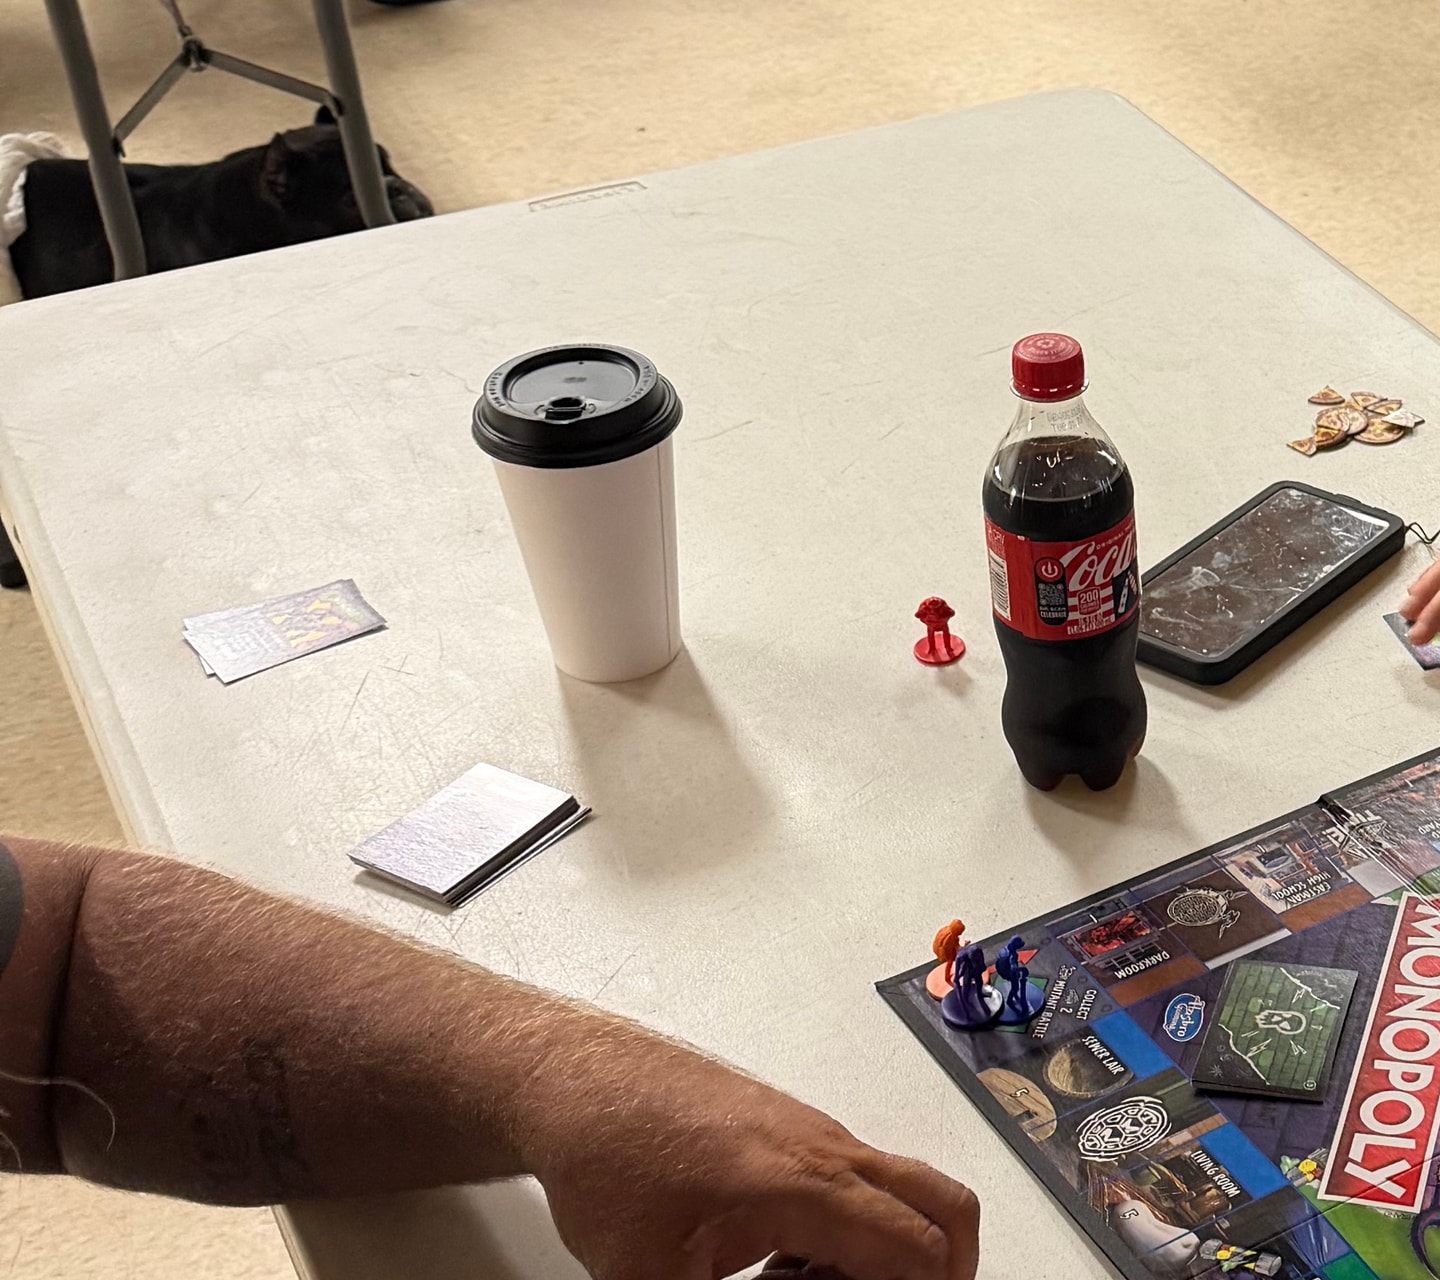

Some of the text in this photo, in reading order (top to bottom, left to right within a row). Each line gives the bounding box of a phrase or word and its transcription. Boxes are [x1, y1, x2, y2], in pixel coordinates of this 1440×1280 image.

[1079, 589, 1100, 604] 200
[1269, 868, 1330, 902] HIGH SCHOOL
[1284, 880, 1331, 907] EASTMAN
[1112, 949, 1170, 980] DARKROOM
[1031, 977, 1066, 1041] MUTANT BATTLE
[1058, 1004, 1073, 1016] 2
[1074, 986, 1097, 1022] COLLECT
[1176, 994, 1204, 1038] Hasbro
[1080, 1031, 1125, 1078] SEWER LAIR
[1188, 1146, 1243, 1201] LIVING ROOM
